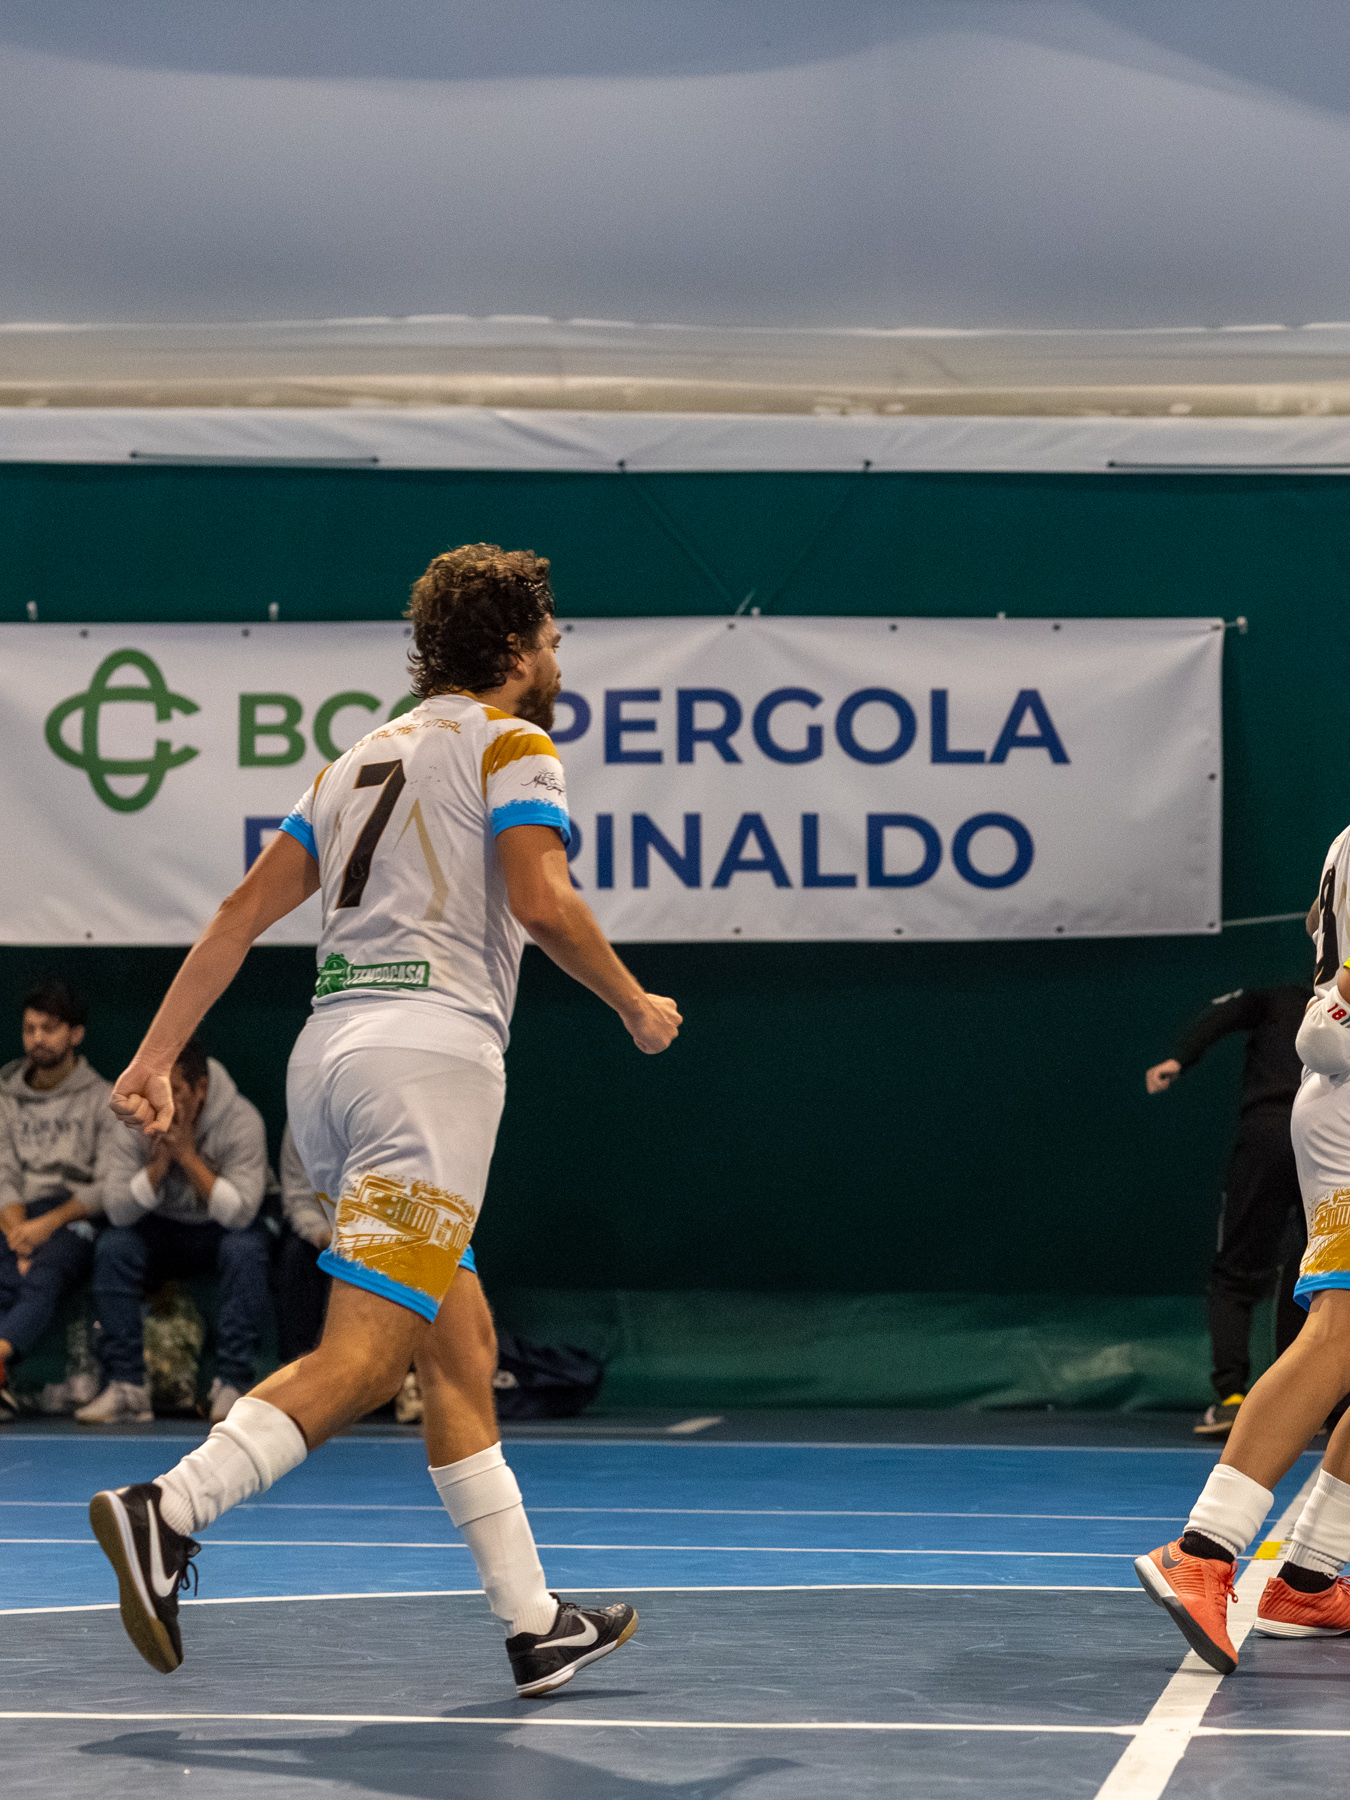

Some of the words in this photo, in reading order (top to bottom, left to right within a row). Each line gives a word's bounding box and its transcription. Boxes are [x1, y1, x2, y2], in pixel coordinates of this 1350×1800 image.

[238, 690, 424, 768] BC
[336, 758, 407, 910] 7
[346, 964, 427, 985] TEMPOCASA
